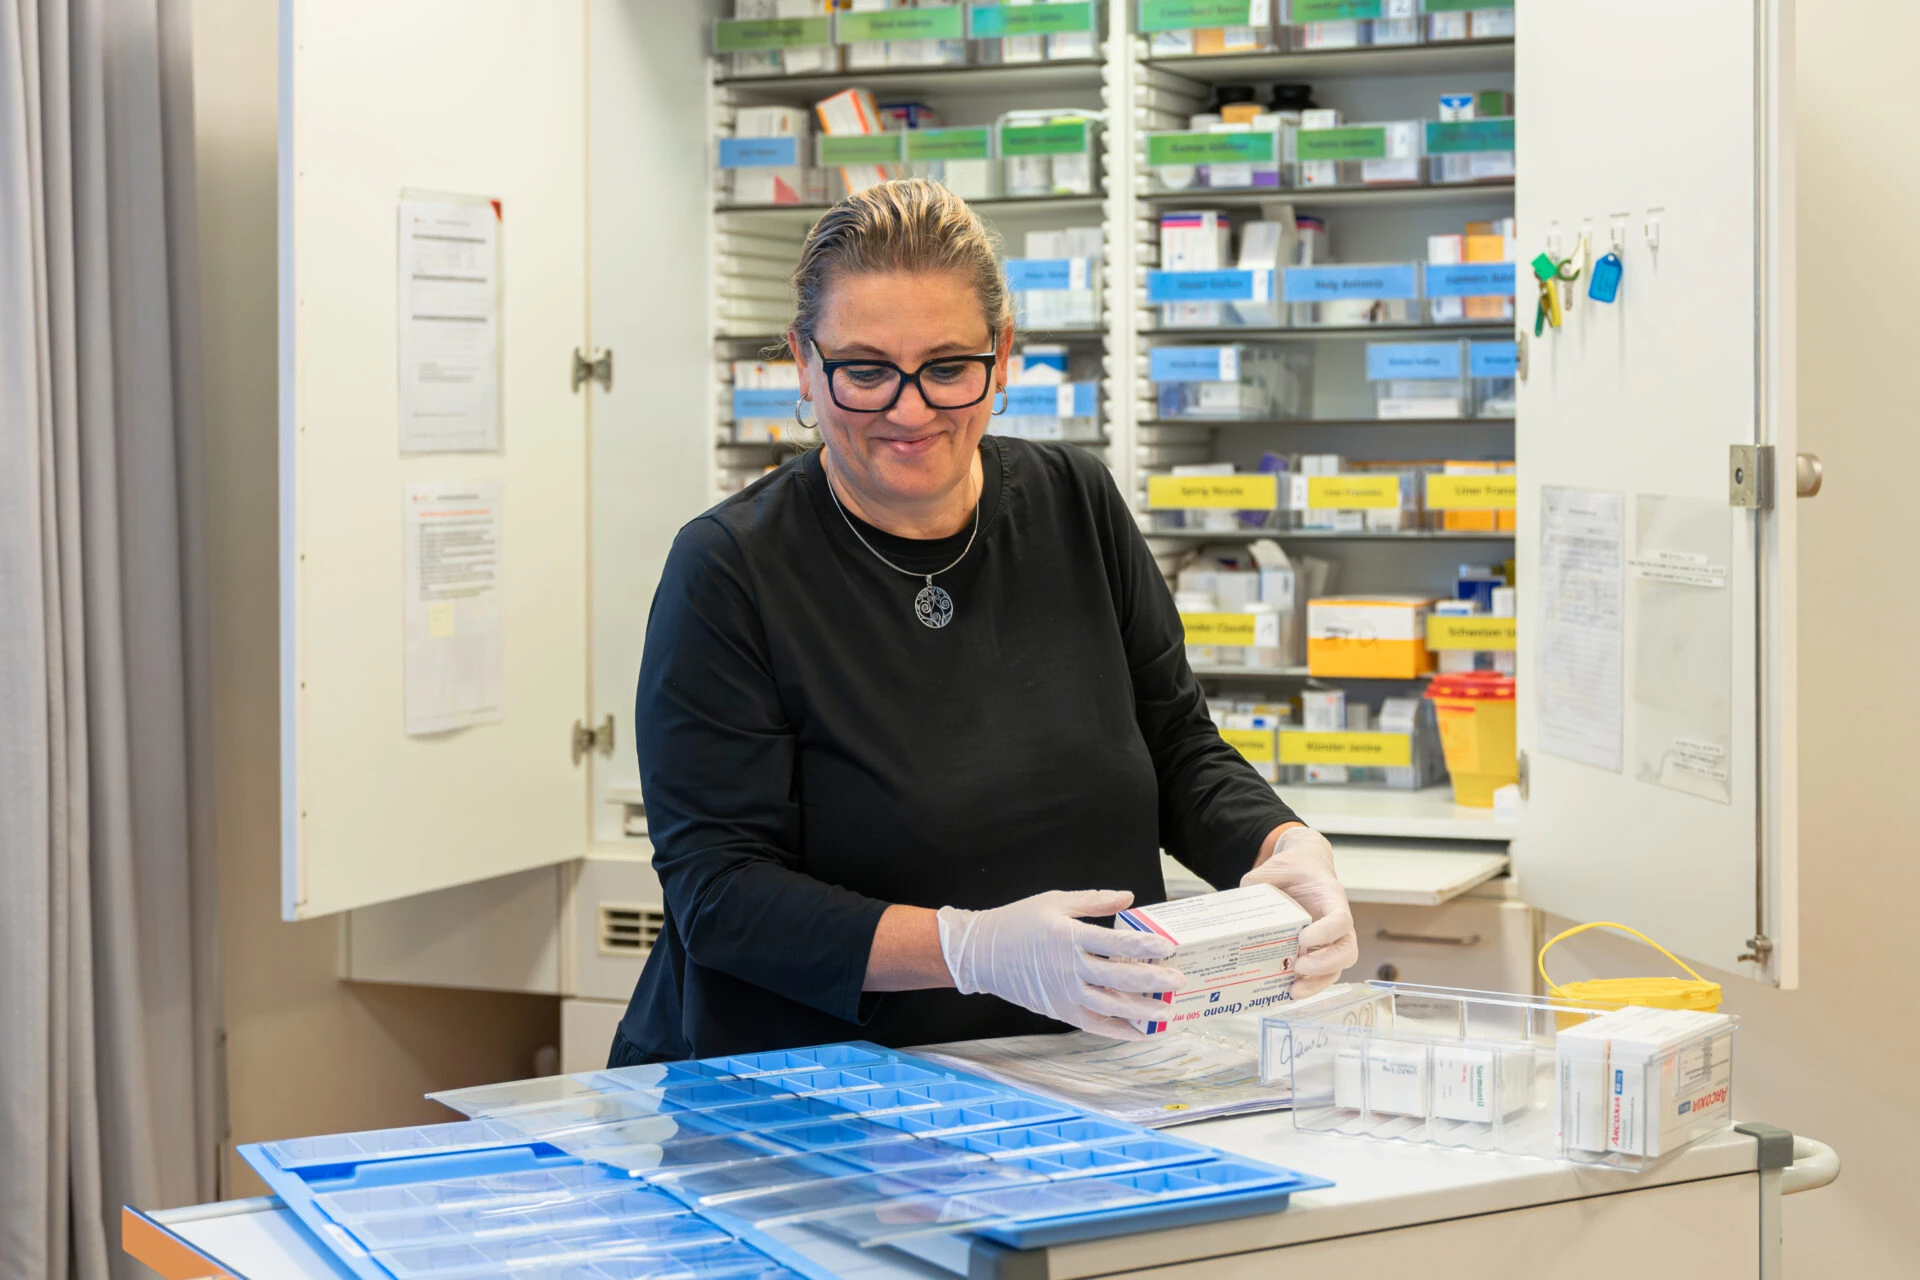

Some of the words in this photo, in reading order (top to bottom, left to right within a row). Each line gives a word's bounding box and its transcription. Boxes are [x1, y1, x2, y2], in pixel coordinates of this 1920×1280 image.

[1186, 1011, 1201, 1020] 500
[1203, 1002, 1242, 1017] Chrono
[1691, 1086, 1728, 1112] ARCOXIA
[1611, 1096, 1622, 1147] ARCOXIA
